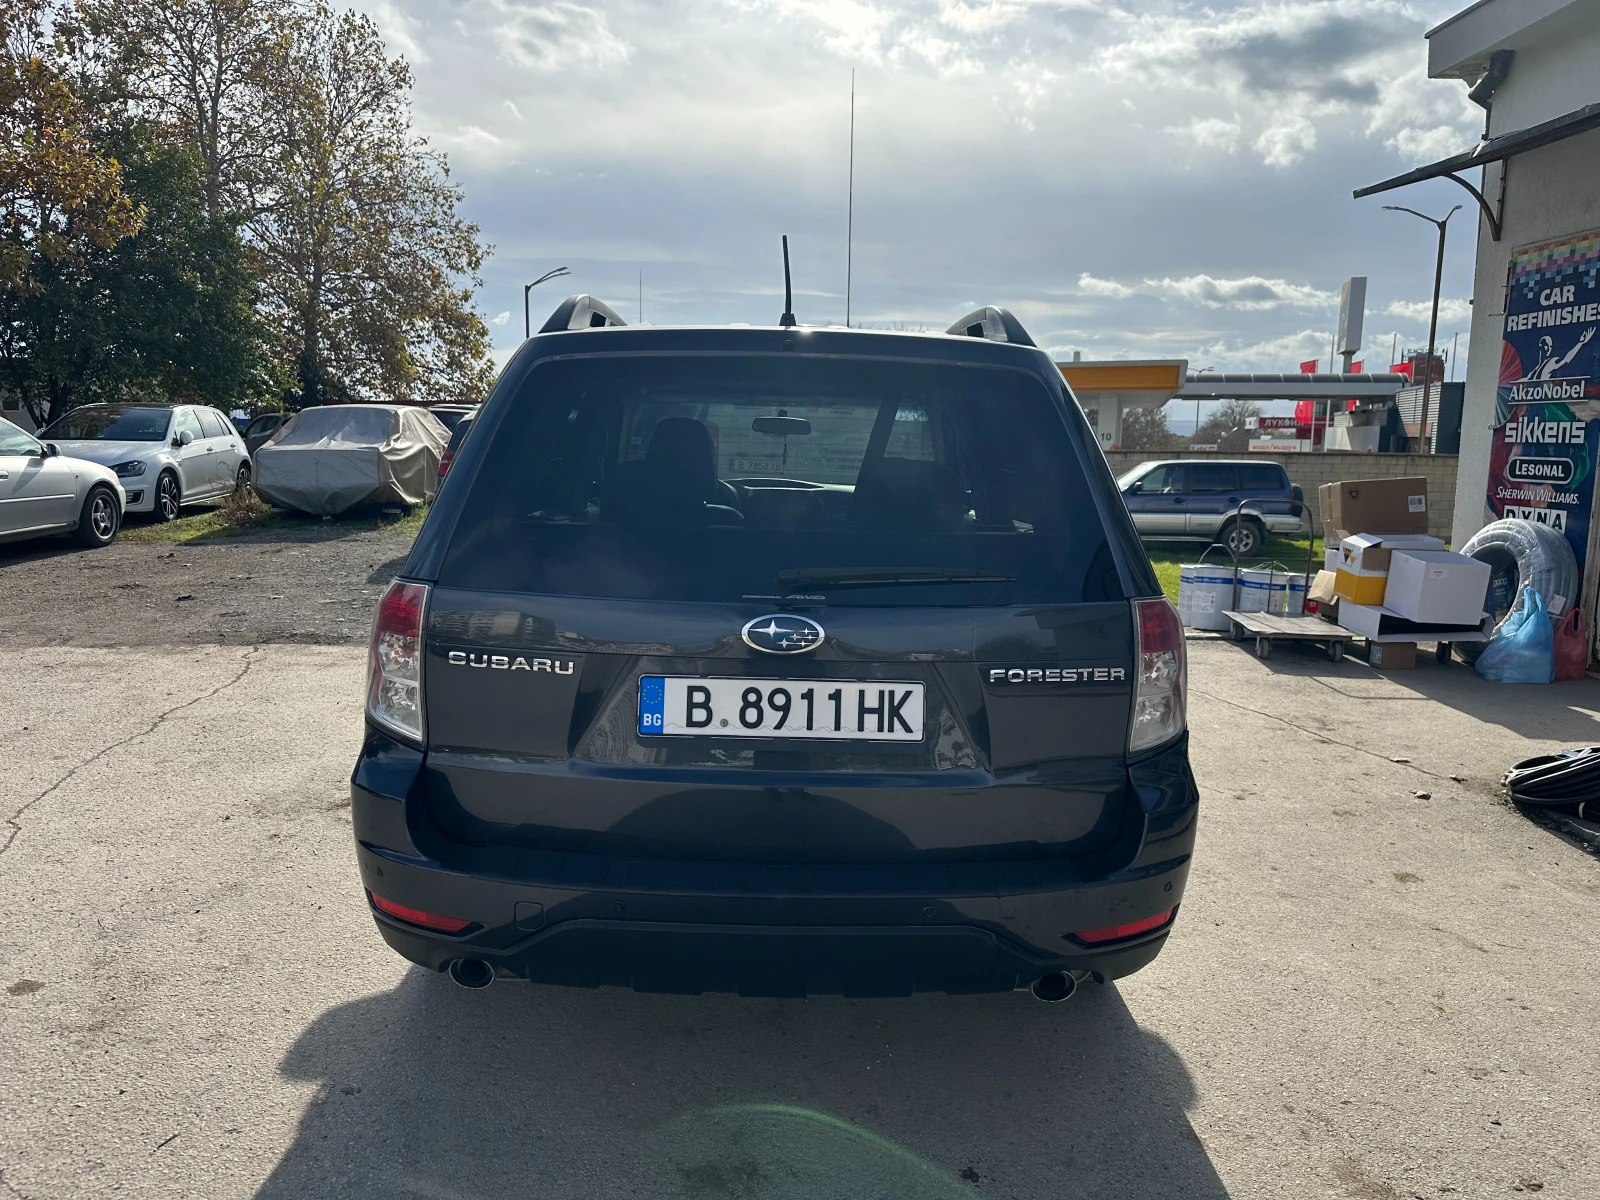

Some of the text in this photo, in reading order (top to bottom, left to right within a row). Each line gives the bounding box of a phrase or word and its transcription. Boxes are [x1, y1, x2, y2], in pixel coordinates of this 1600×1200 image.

[1540, 285, 1575, 306] CAR
[1507, 303, 1600, 332] REFINISHE
[1509, 380, 1585, 401] AkzoNobel
[1100, 432, 1112, 441] 10
[1504, 416, 1586, 444] sikkens
[1515, 459, 1565, 477] LESONAL
[1496, 486, 1535, 501] SHERWIN
[448, 651, 574, 675] SUBARU
[989, 667, 1126, 683] FORESTER
[643, 713, 662, 726] BG
